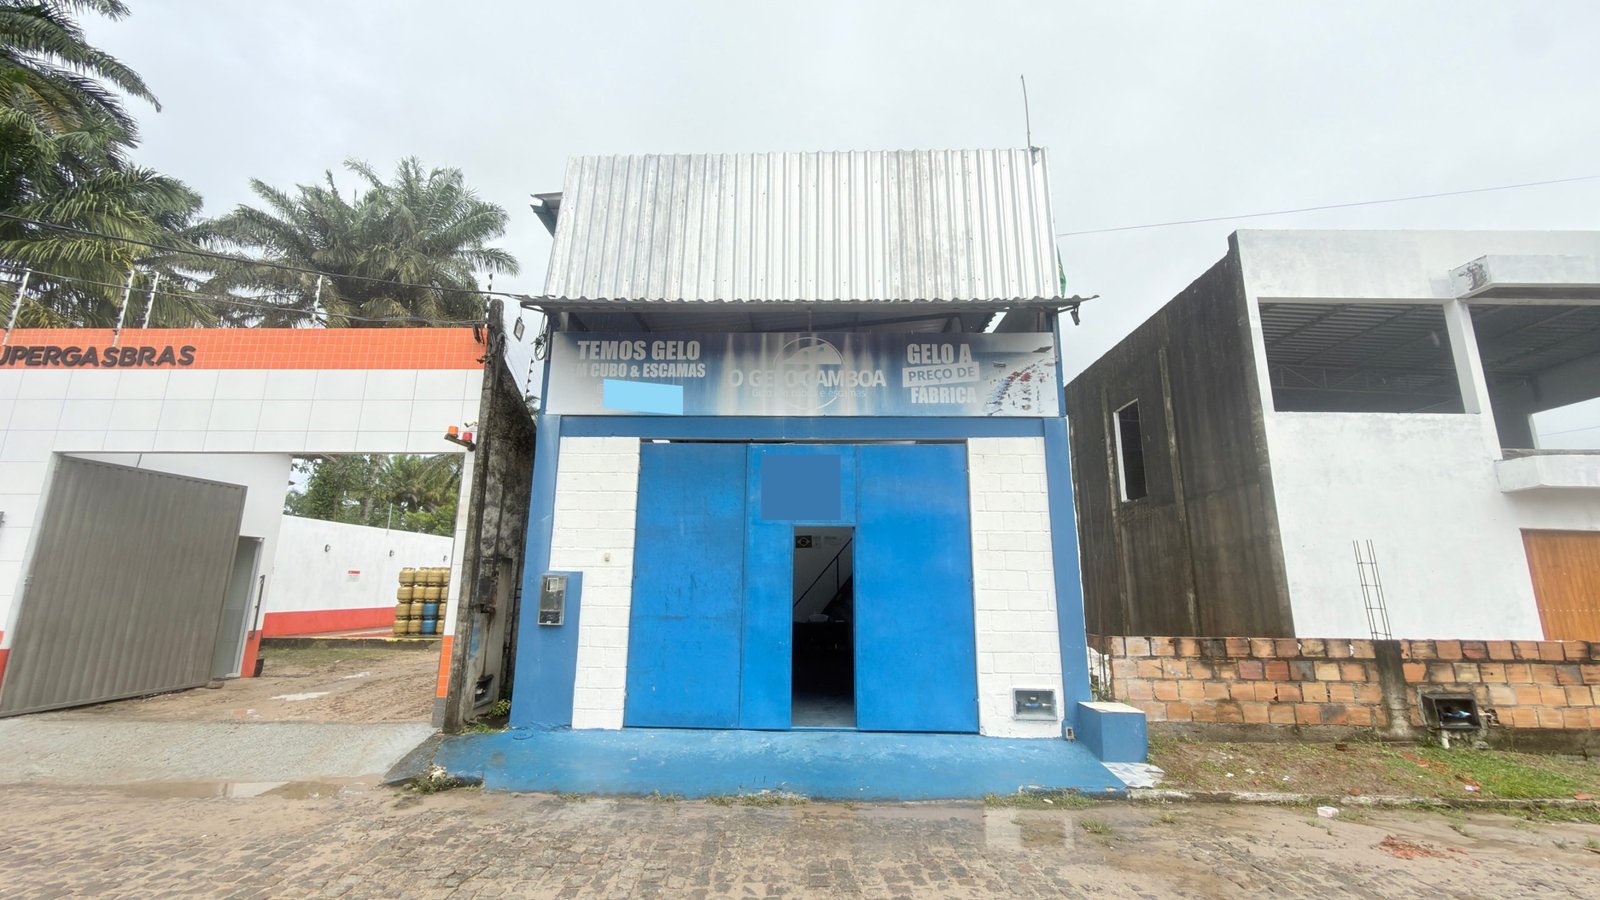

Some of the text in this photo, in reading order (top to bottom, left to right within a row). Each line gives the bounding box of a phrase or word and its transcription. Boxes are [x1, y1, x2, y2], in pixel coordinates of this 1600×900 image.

[577, 340, 701, 361] TEMOS GELO
[907, 343, 973, 365] GELO A
[590, 363, 628, 378] CUBO
[630, 366, 641, 378] &
[642, 363, 706, 378] ESCAMAS
[748, 369, 799, 388] GEO
[908, 366, 976, 383] PREÇO DE
